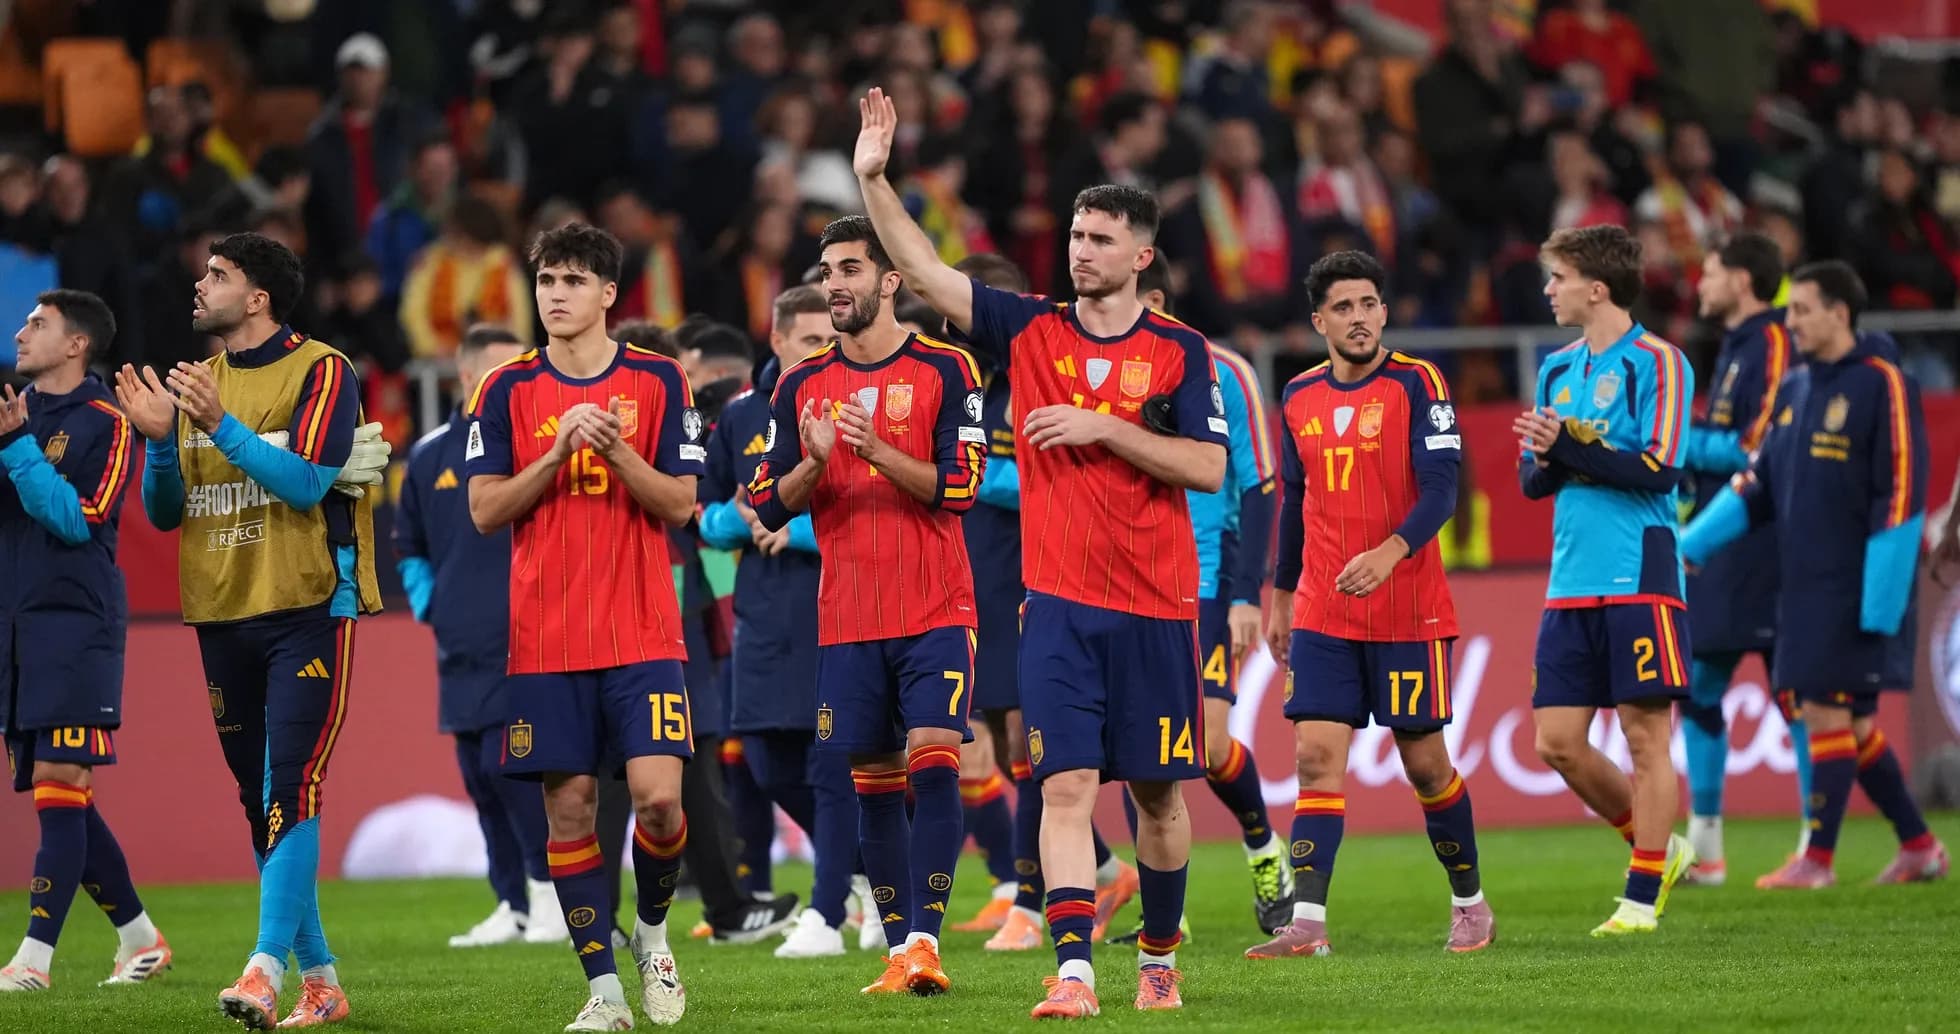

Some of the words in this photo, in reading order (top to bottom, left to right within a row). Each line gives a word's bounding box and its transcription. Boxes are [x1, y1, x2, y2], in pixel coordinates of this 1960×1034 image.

[571, 449, 608, 496] 15
[1324, 447, 1354, 492] 17
[1203, 644, 1228, 687] 4
[1632, 636, 1657, 682] 2
[943, 671, 964, 716] 7
[1389, 671, 1424, 716] 17
[649, 693, 686, 741] 15
[1159, 717, 1195, 765] 14
